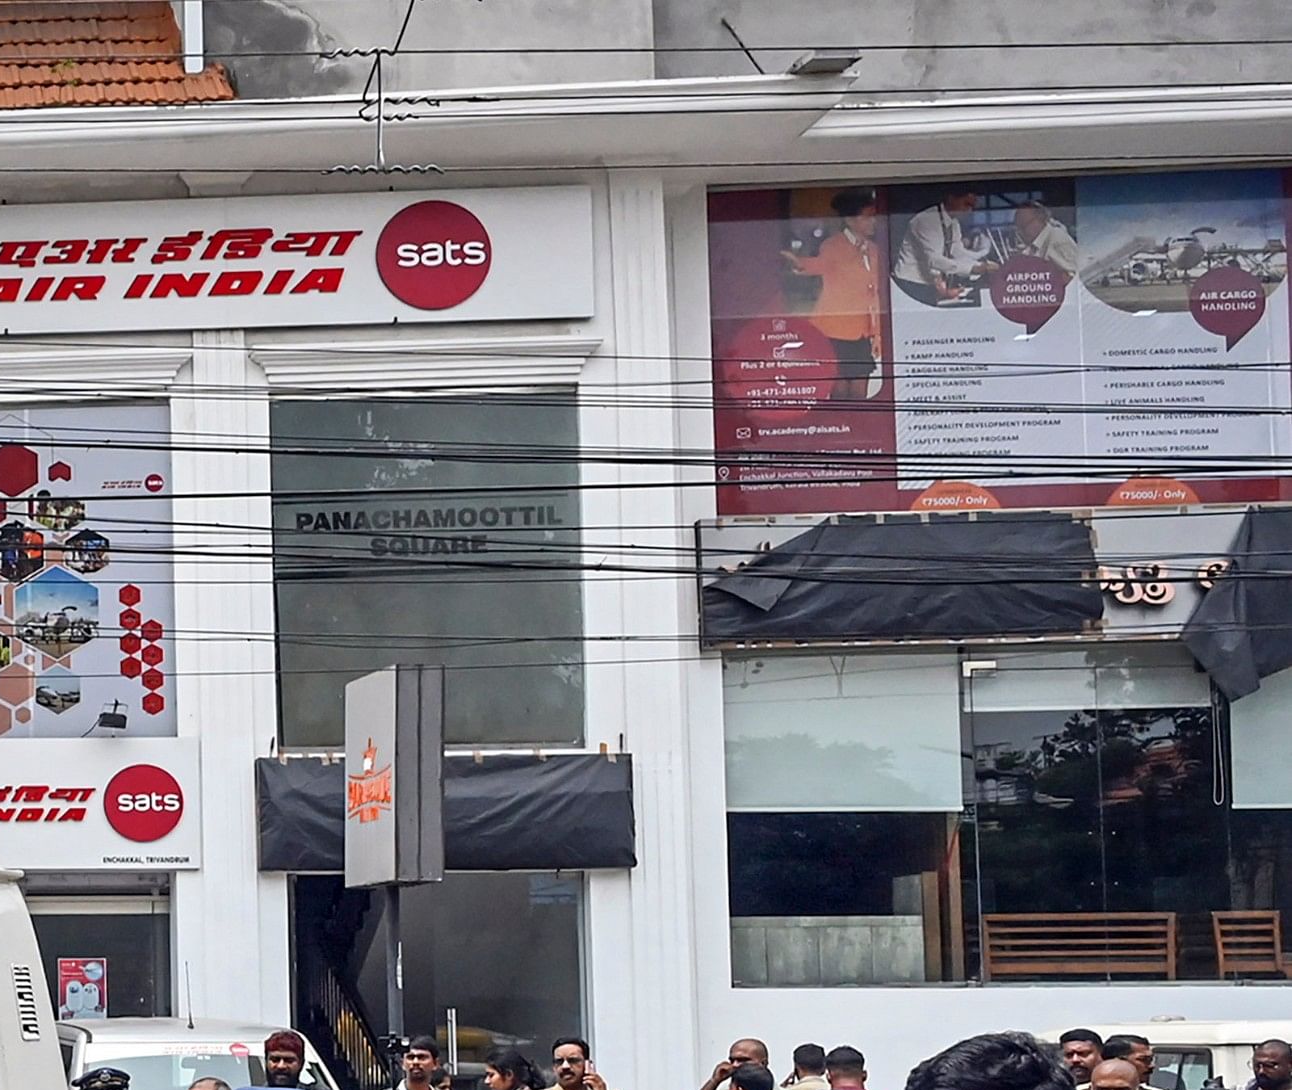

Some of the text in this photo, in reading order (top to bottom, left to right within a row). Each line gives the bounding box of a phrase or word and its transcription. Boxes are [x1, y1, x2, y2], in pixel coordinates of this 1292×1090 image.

[396, 237, 487, 268] sats
[1006, 272, 1050, 282] AIRPORT
[123, 267, 345, 299] INDIA
[1006, 283, 1052, 293] GROUND
[1002, 294, 1056, 304] HANDLING
[1200, 290, 1256, 300] AIR CARGO
[1201, 302, 1256, 311] HANDLING
[767, 332, 799, 341] months
[957, 336, 996, 344] HANDLING
[934, 351, 974, 359] HANDLING
[1108, 349, 1148, 357] DOMESTIC
[911, 379, 983, 388] SPECIAL HANDLING
[1110, 381, 1155, 389] PERISHABLE
[913, 419, 1062, 431] PERSONALITY DEVELOPMENT PROGRAM
[1112, 430, 1139, 438] SAFETY
[1141, 429, 1178, 437] TRAINING
[914, 435, 1020, 446] SAFETY TRAINING PROGRAM
[1163, 489, 1186, 500] Only
[965, 495, 988, 506] Only
[296, 505, 563, 532] PANACHAMOOTTIL
[370, 535, 488, 557] SQUARE
[117, 793, 180, 812] sats
[145, 855, 190, 864] TRIVANDRUM
